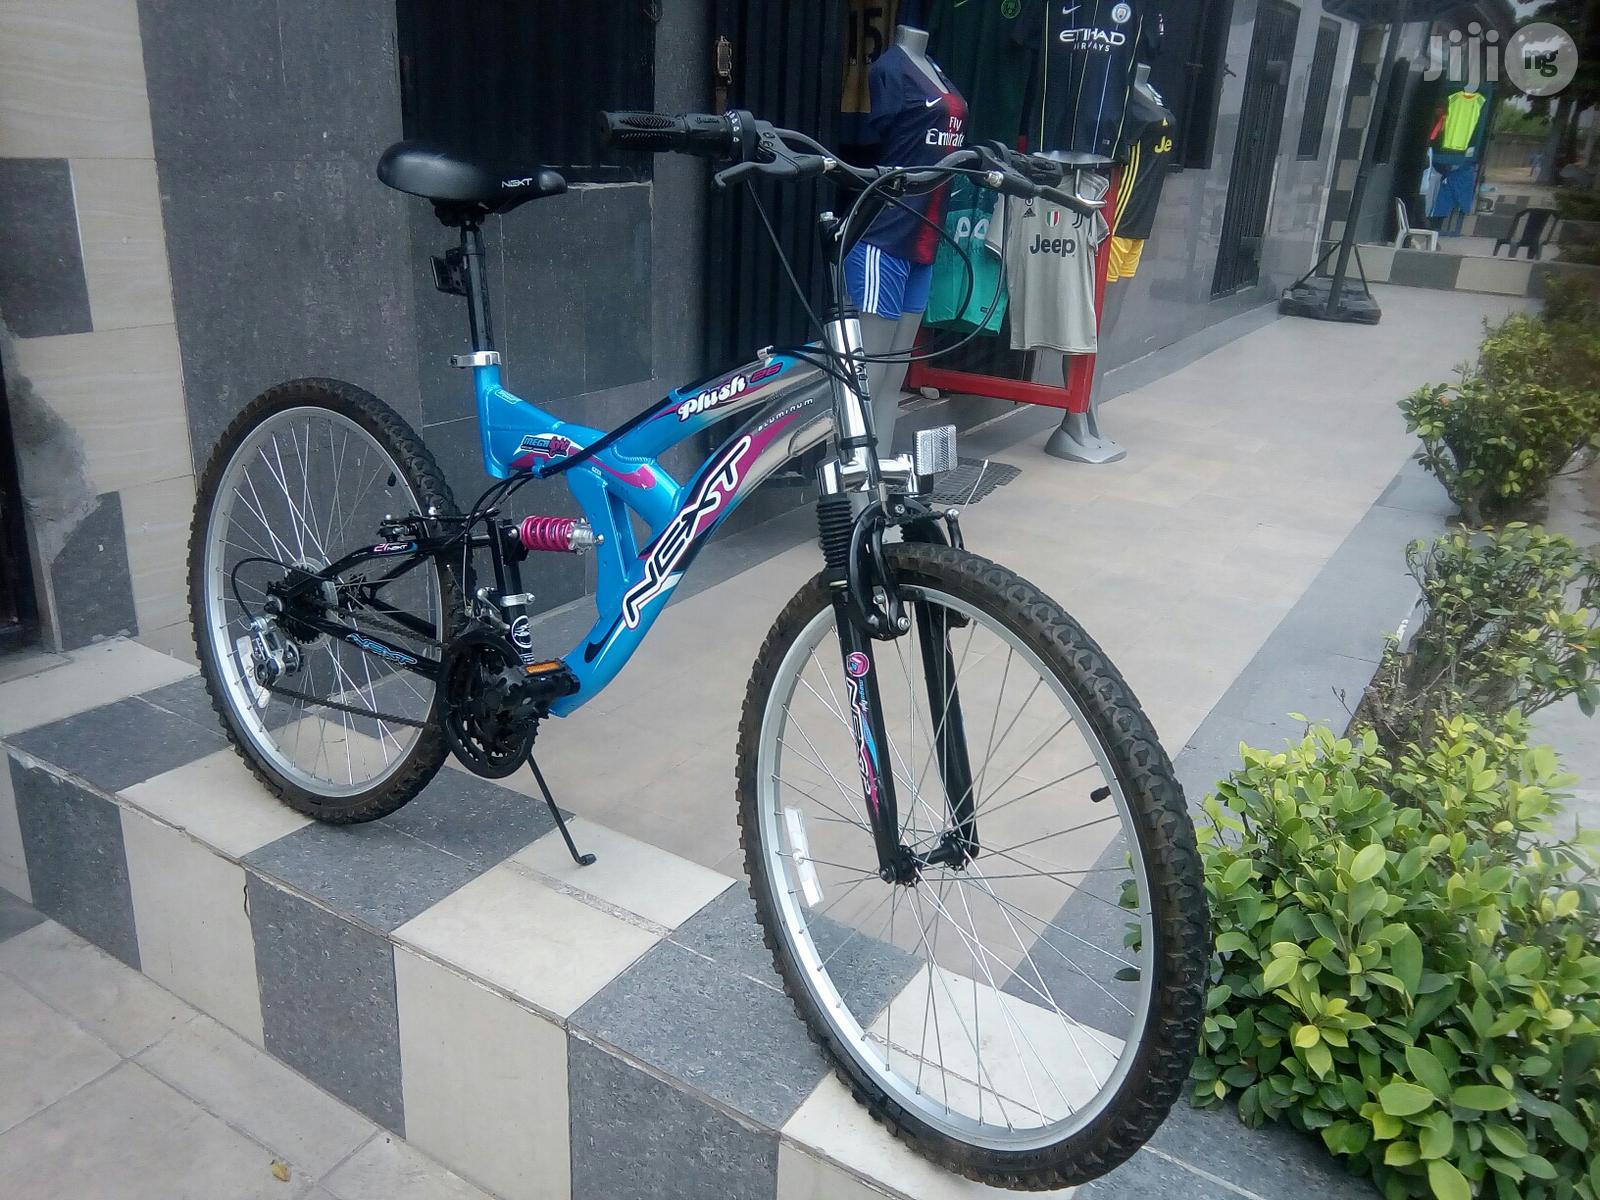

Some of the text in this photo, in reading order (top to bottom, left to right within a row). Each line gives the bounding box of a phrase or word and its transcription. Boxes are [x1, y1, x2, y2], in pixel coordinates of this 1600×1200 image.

[1060, 27, 1126, 46] ETIHAD
[949, 116, 962, 131] Fly
[501, 177, 533, 189] NEXT
[1029, 233, 1076, 258] Jeep
[677, 374, 746, 421] Plush
[622, 434, 752, 629] NEXT
